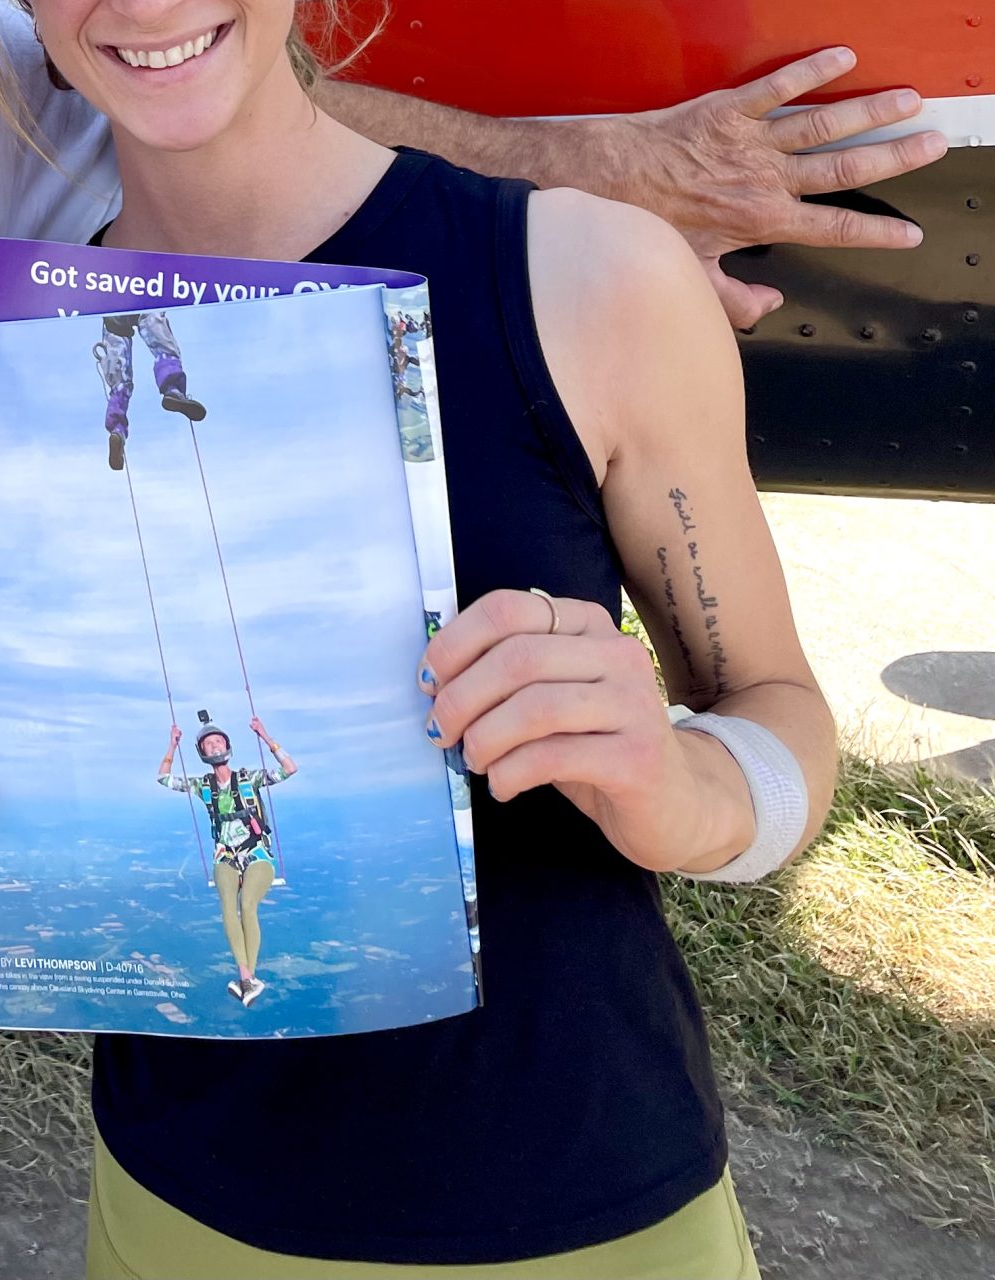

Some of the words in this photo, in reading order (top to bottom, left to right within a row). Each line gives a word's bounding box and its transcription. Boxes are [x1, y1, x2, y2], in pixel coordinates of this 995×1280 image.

[30, 261, 78, 289] Got
[85, 271, 164, 298] saved
[173, 273, 207, 305] by
[692, 566, 718, 612] small
[0, 957, 13, 968] BY
[106, 962, 144, 974] D-40716
